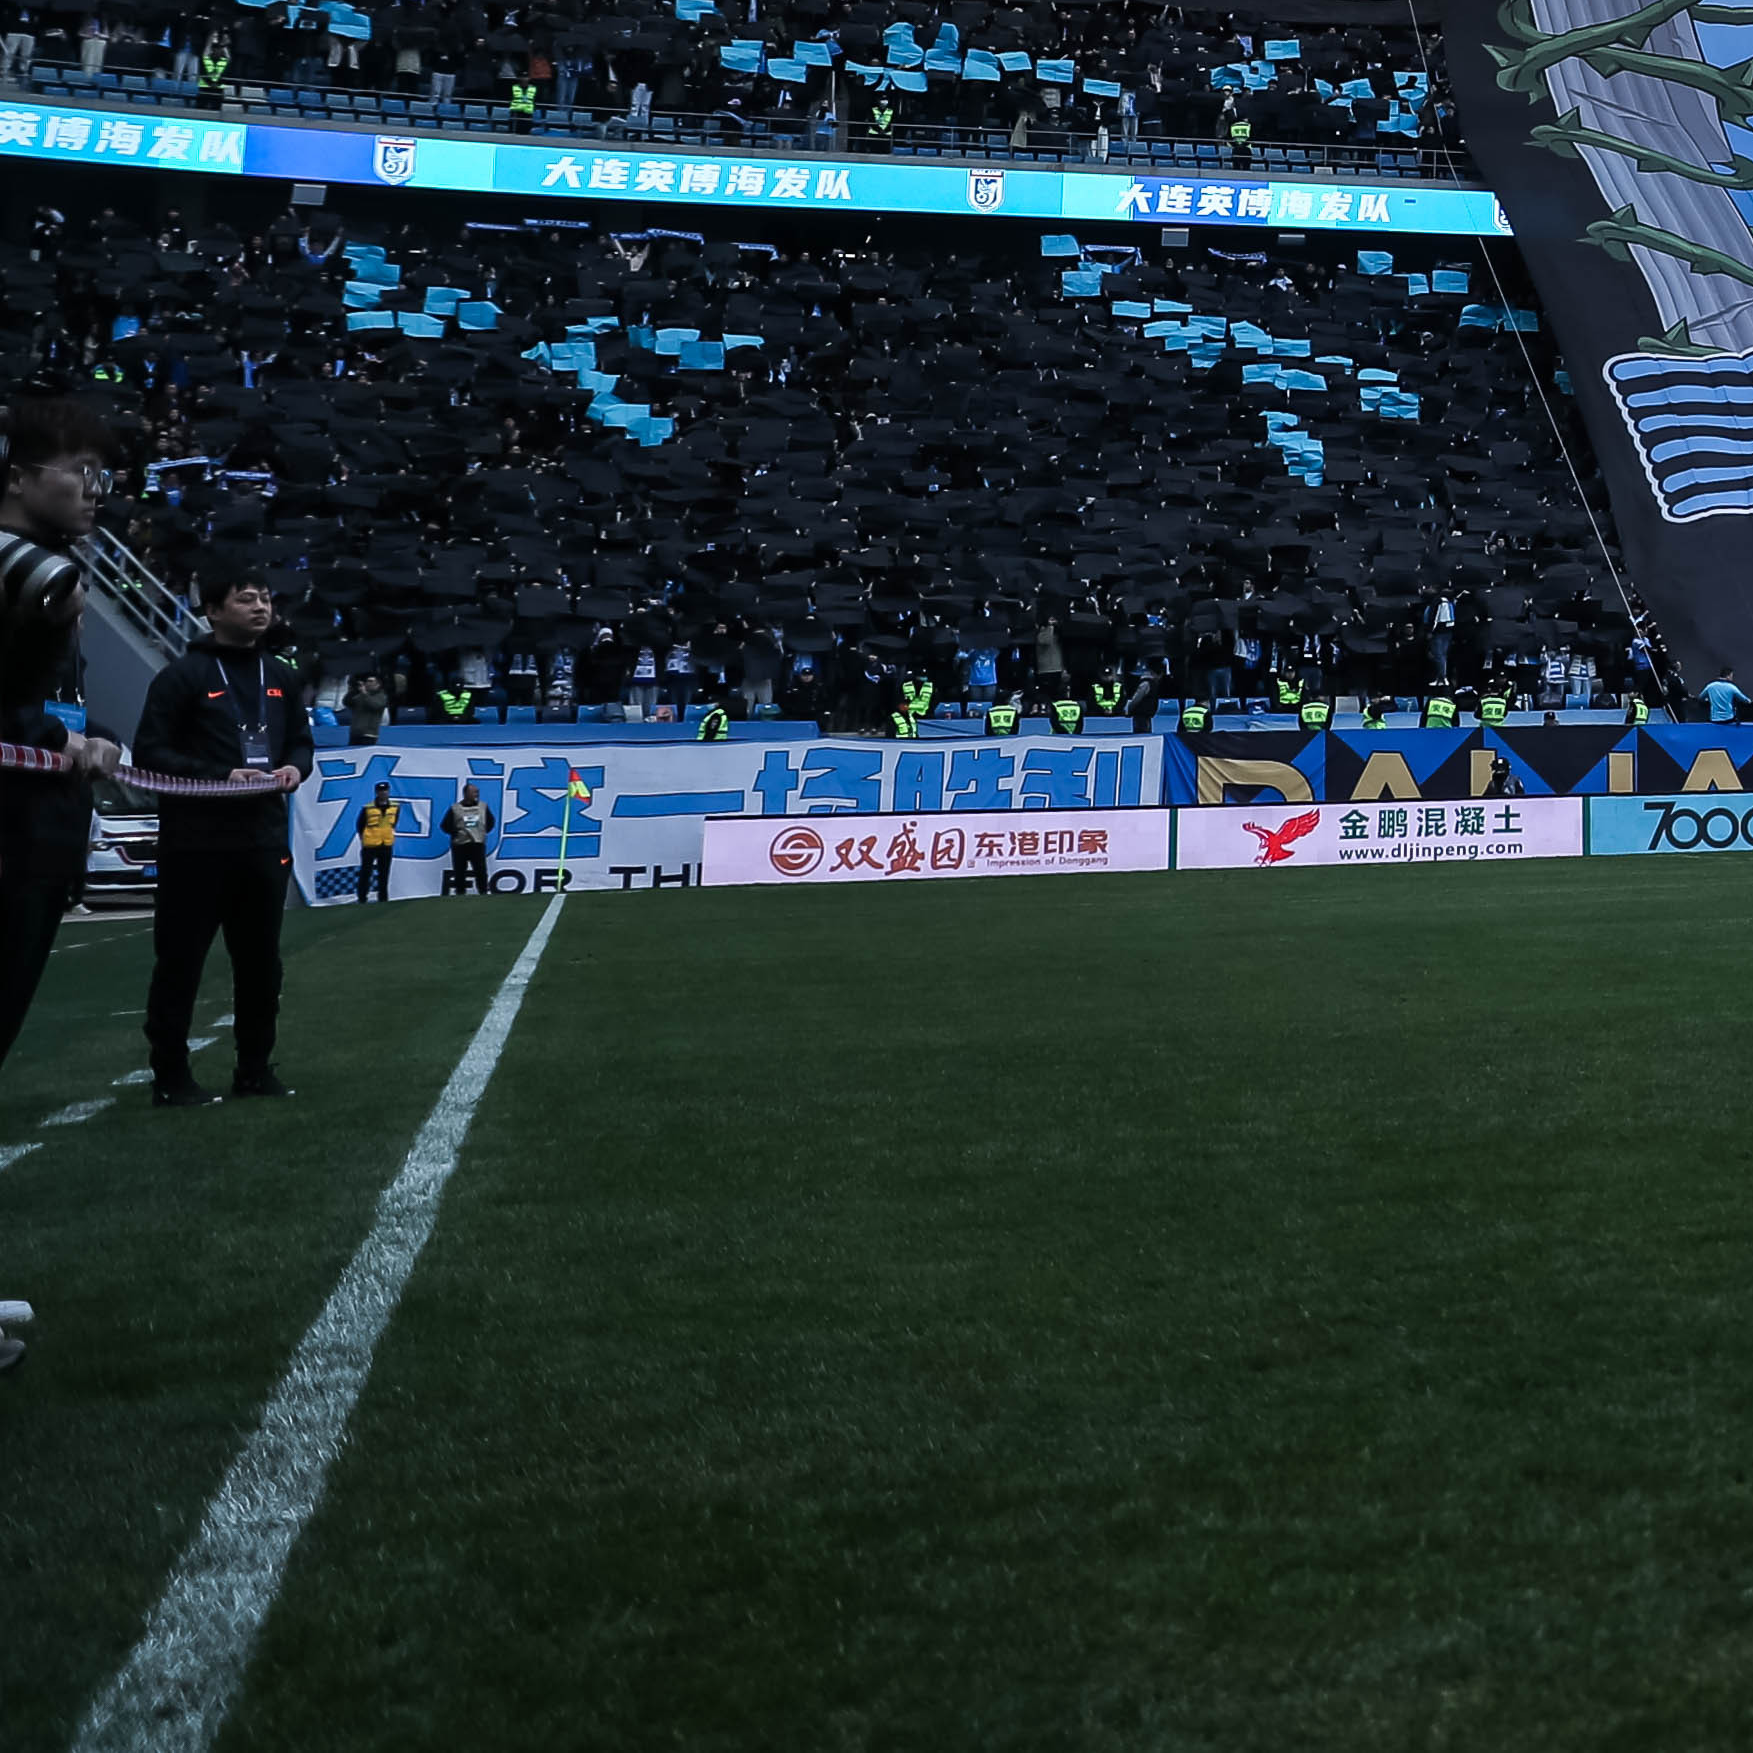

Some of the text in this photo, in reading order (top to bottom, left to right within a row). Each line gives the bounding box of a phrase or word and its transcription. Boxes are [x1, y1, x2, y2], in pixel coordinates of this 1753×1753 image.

[0, 110, 241, 165] 英博海发队
[541, 156, 853, 201] 大连英博海发队
[1115, 184, 1392, 224] 大连英博海发队
[1338, 804, 1523, 841] 金鹏混凝土
[974, 829, 1109, 857] 东港印象
[1338, 840, 1523, 862] www.dljinpeng.com
[987, 856, 1109, 868] Impression of Donggang
